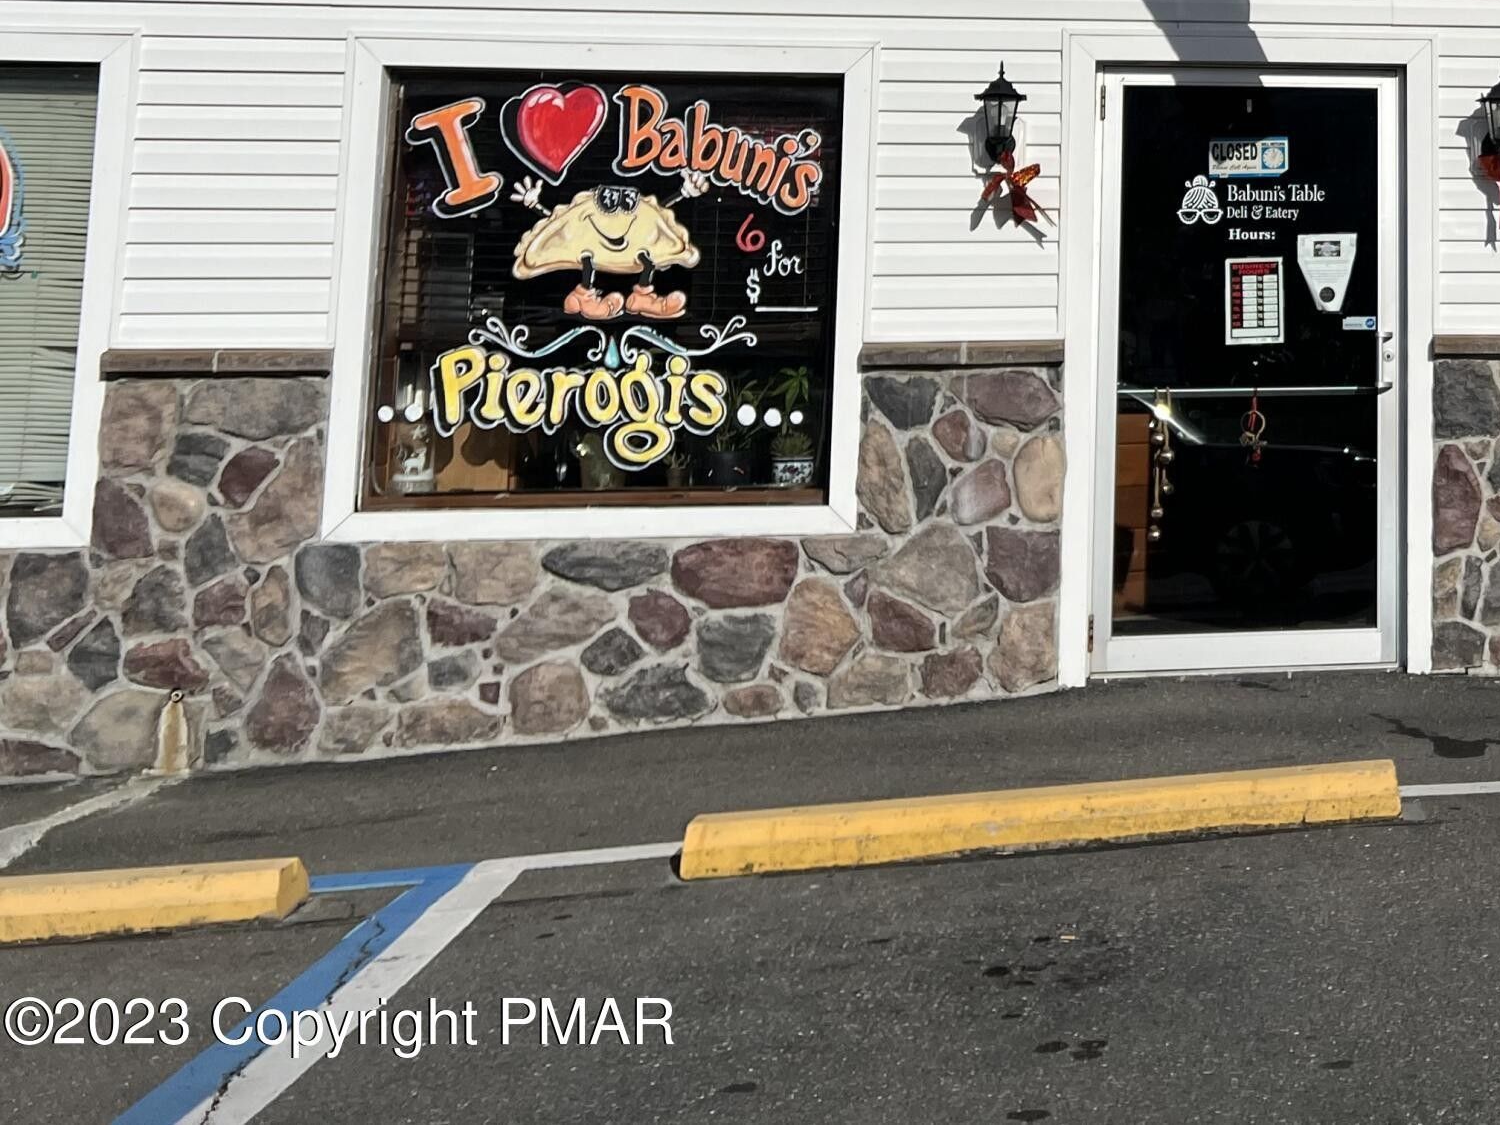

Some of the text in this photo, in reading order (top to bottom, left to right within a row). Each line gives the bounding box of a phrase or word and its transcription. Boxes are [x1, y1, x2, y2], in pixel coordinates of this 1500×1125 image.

[407, 84, 822, 218] I Babuni's
[1211, 142, 1258, 161] CLOSED
[1227, 183, 1325, 202] Babuni's Table
[1226, 204, 1299, 221] Deli & Eatery
[1228, 228, 1275, 240] Hours:
[736, 213, 804, 276] 6 for
